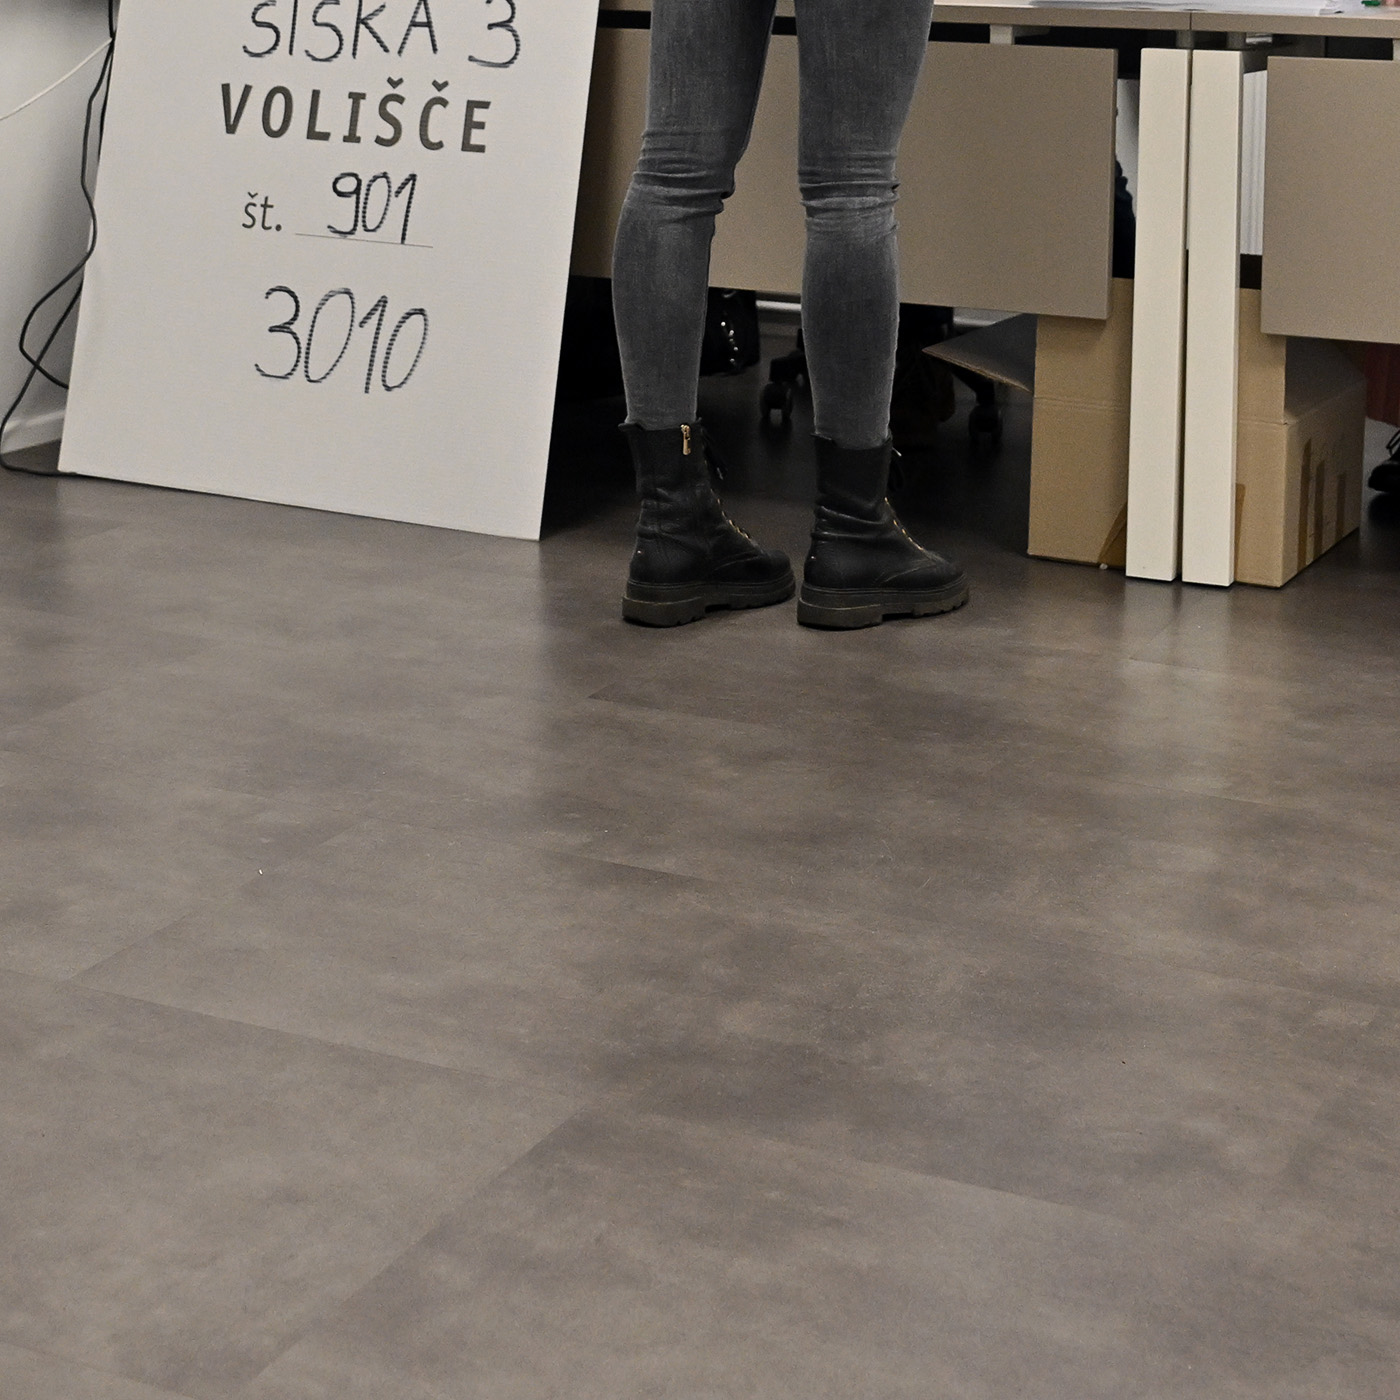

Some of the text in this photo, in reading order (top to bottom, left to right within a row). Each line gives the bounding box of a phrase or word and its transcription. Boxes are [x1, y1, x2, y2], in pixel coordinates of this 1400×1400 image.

[221, 77, 491, 153] VOLIŠČE
[242, 172, 417, 243] št. 901
[255, 286, 428, 393] 3010
